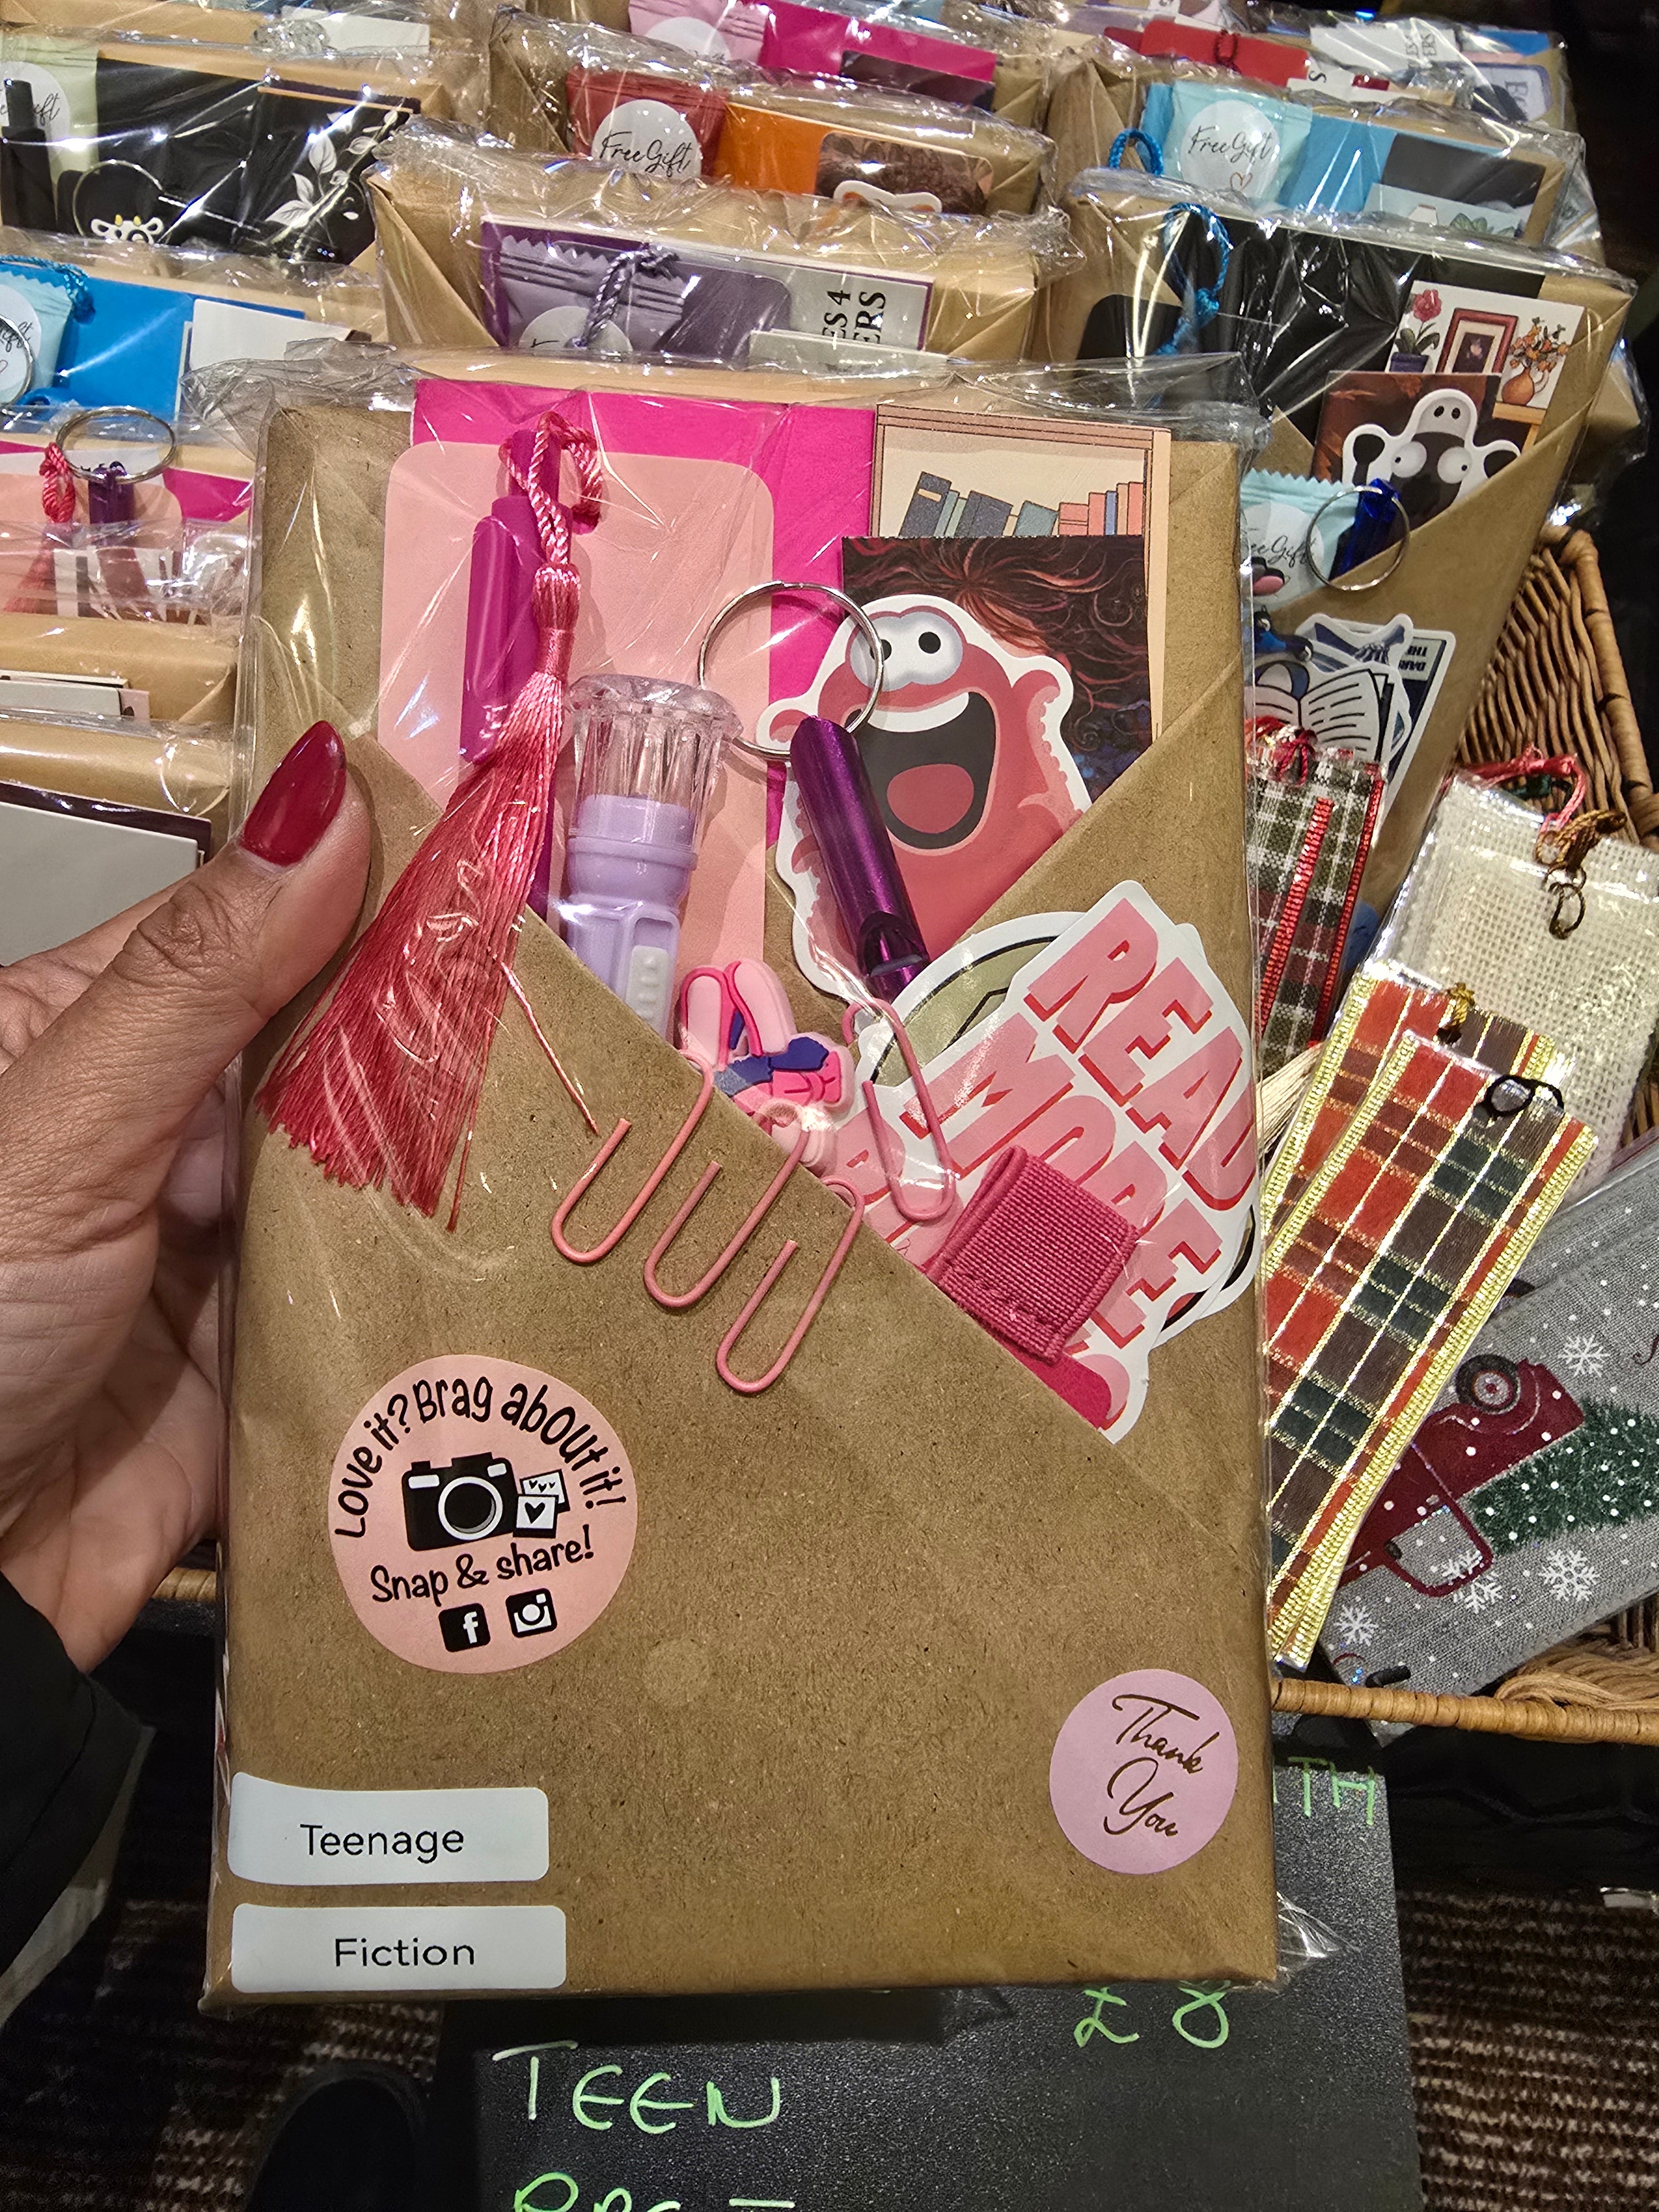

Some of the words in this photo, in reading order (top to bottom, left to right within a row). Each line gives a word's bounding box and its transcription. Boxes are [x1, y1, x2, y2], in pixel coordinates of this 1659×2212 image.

[599, 130, 645, 163] Free
[645, 139, 692, 178] Gift
[1188, 126, 1231, 154] Free
[827, 290, 851, 305] 4
[334, 1446, 383, 1538] Love
[363, 1394, 409, 1451] it?
[412, 1375, 493, 1424] Brag
[500, 1383, 609, 1471] about
[578, 1466, 627, 1509] it!
[371, 1564, 449, 1607] Snap
[455, 1553, 489, 1589] &
[497, 1524, 594, 1579] share!
[1112, 1694, 1220, 1775] Thank
[1103, 1757, 1178, 1835] You
[299, 1823, 465, 1865] Teenage
[335, 1937, 475, 1967] Fiction
[492, 2039, 780, 2135] TEEN
